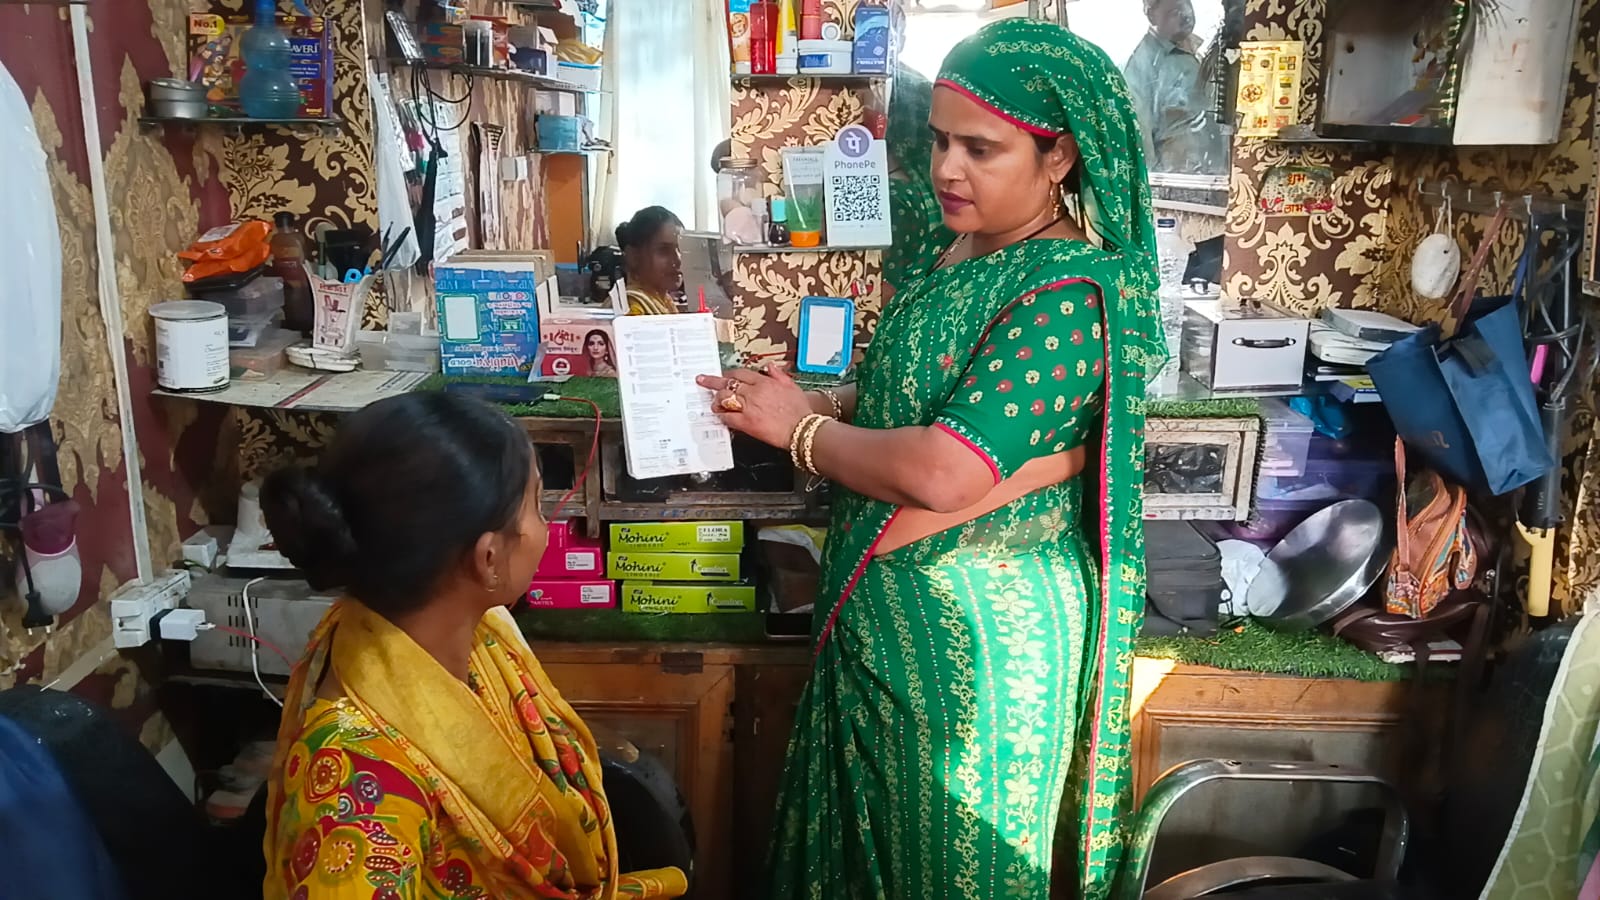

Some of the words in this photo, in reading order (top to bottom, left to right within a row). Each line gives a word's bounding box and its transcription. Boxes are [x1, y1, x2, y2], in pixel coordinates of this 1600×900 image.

[194, 19, 217, 28] No.1
[291, 43, 319, 53] AVERI
[845, 131, 862, 153] पे
[834, 160, 876, 169] PhonePe
[1287, 173, 1306, 185] शुभ
[1284, 203, 1304, 214] लाभ
[618, 532, 667, 544] Mohini
[615, 561, 663, 572] Mohini
[630, 594, 679, 605] Mohini
